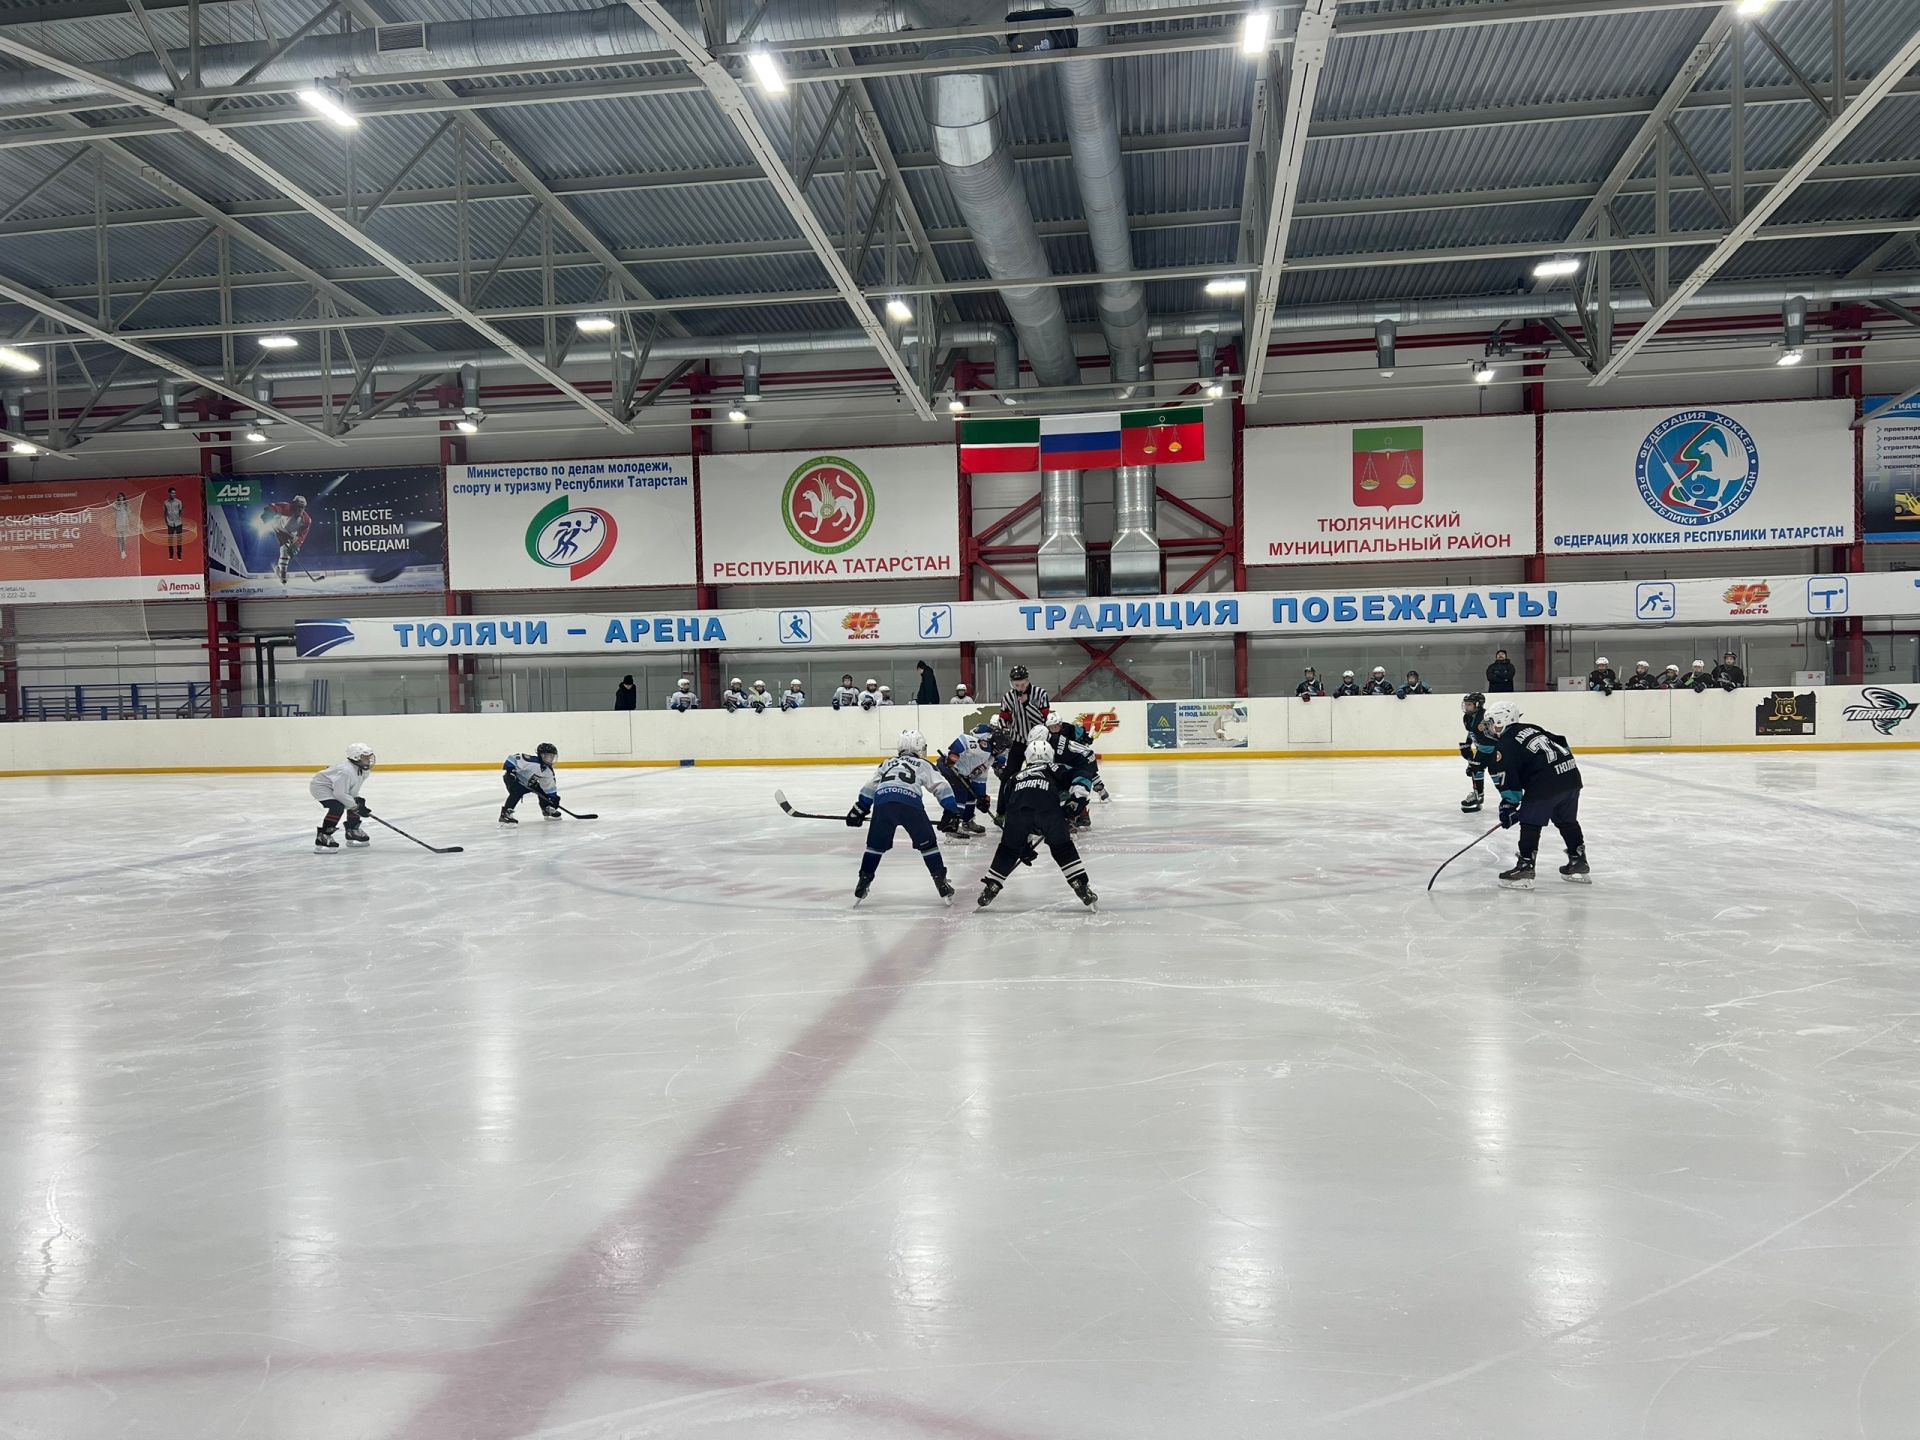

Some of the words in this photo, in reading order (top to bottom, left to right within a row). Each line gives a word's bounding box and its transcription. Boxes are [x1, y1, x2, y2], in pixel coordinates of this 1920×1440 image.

[1641, 412, 1706, 458] ФЕДЕРАЦИЯ
[1715, 414, 1755, 454] ХОККЕЯ
[467, 465, 548, 480] Министерство
[551, 466, 565, 477] по
[568, 463, 605, 477] делам
[608, 460, 672, 475] молодежи,
[453, 483, 491, 495] спорту
[494, 483, 501, 493] и
[504, 480, 551, 495] туризму
[555, 477, 624, 492] Республики
[628, 475, 688, 489] Татарстан
[1638, 476, 1697, 525] РЕСПУБЛИКИ
[1704, 471, 1757, 523] ТАТАРСТАН
[342, 509, 393, 522] ВМЕСТЕ
[1317, 510, 1461, 532] ТЮЛЯЧИНСКИЙ
[62, 527, 80, 539] 4G
[342, 526, 352, 537] К
[354, 523, 404, 536] НОВЫМ
[1554, 533, 1628, 548] ФЕДЕРАЦИЯ
[1632, 531, 1680, 545] ХОККЕЯ
[1684, 529, 1767, 543] РЕСПУБЛИКИ
[1770, 526, 1844, 540] ТАТАРСТАН
[343, 538, 410, 553] ПОБЕДАМ!
[1268, 533, 1441, 557] МУНИЦИПАЛЬНЫЙ
[1447, 532, 1511, 550] РАЙОН
[713, 559, 838, 577] РЕСПУБЛИКА
[843, 556, 950, 575] ТАТАРСТАН
[169, 580, 201, 591] Летай
[1019, 599, 1239, 632] ТРАДИЦИЯ
[1272, 590, 1558, 624] ПОБЕЖДАТЬ!
[393, 620, 548, 648] ТЮЛЯЧИ
[604, 616, 727, 644] АРЕНА
[1780, 704, 1793, 714] 16
[1848, 707, 1912, 720] TORNADO
[968, 740, 978, 750] 13
[1526, 734, 1570, 764] 71
[881, 761, 917, 785] 23
